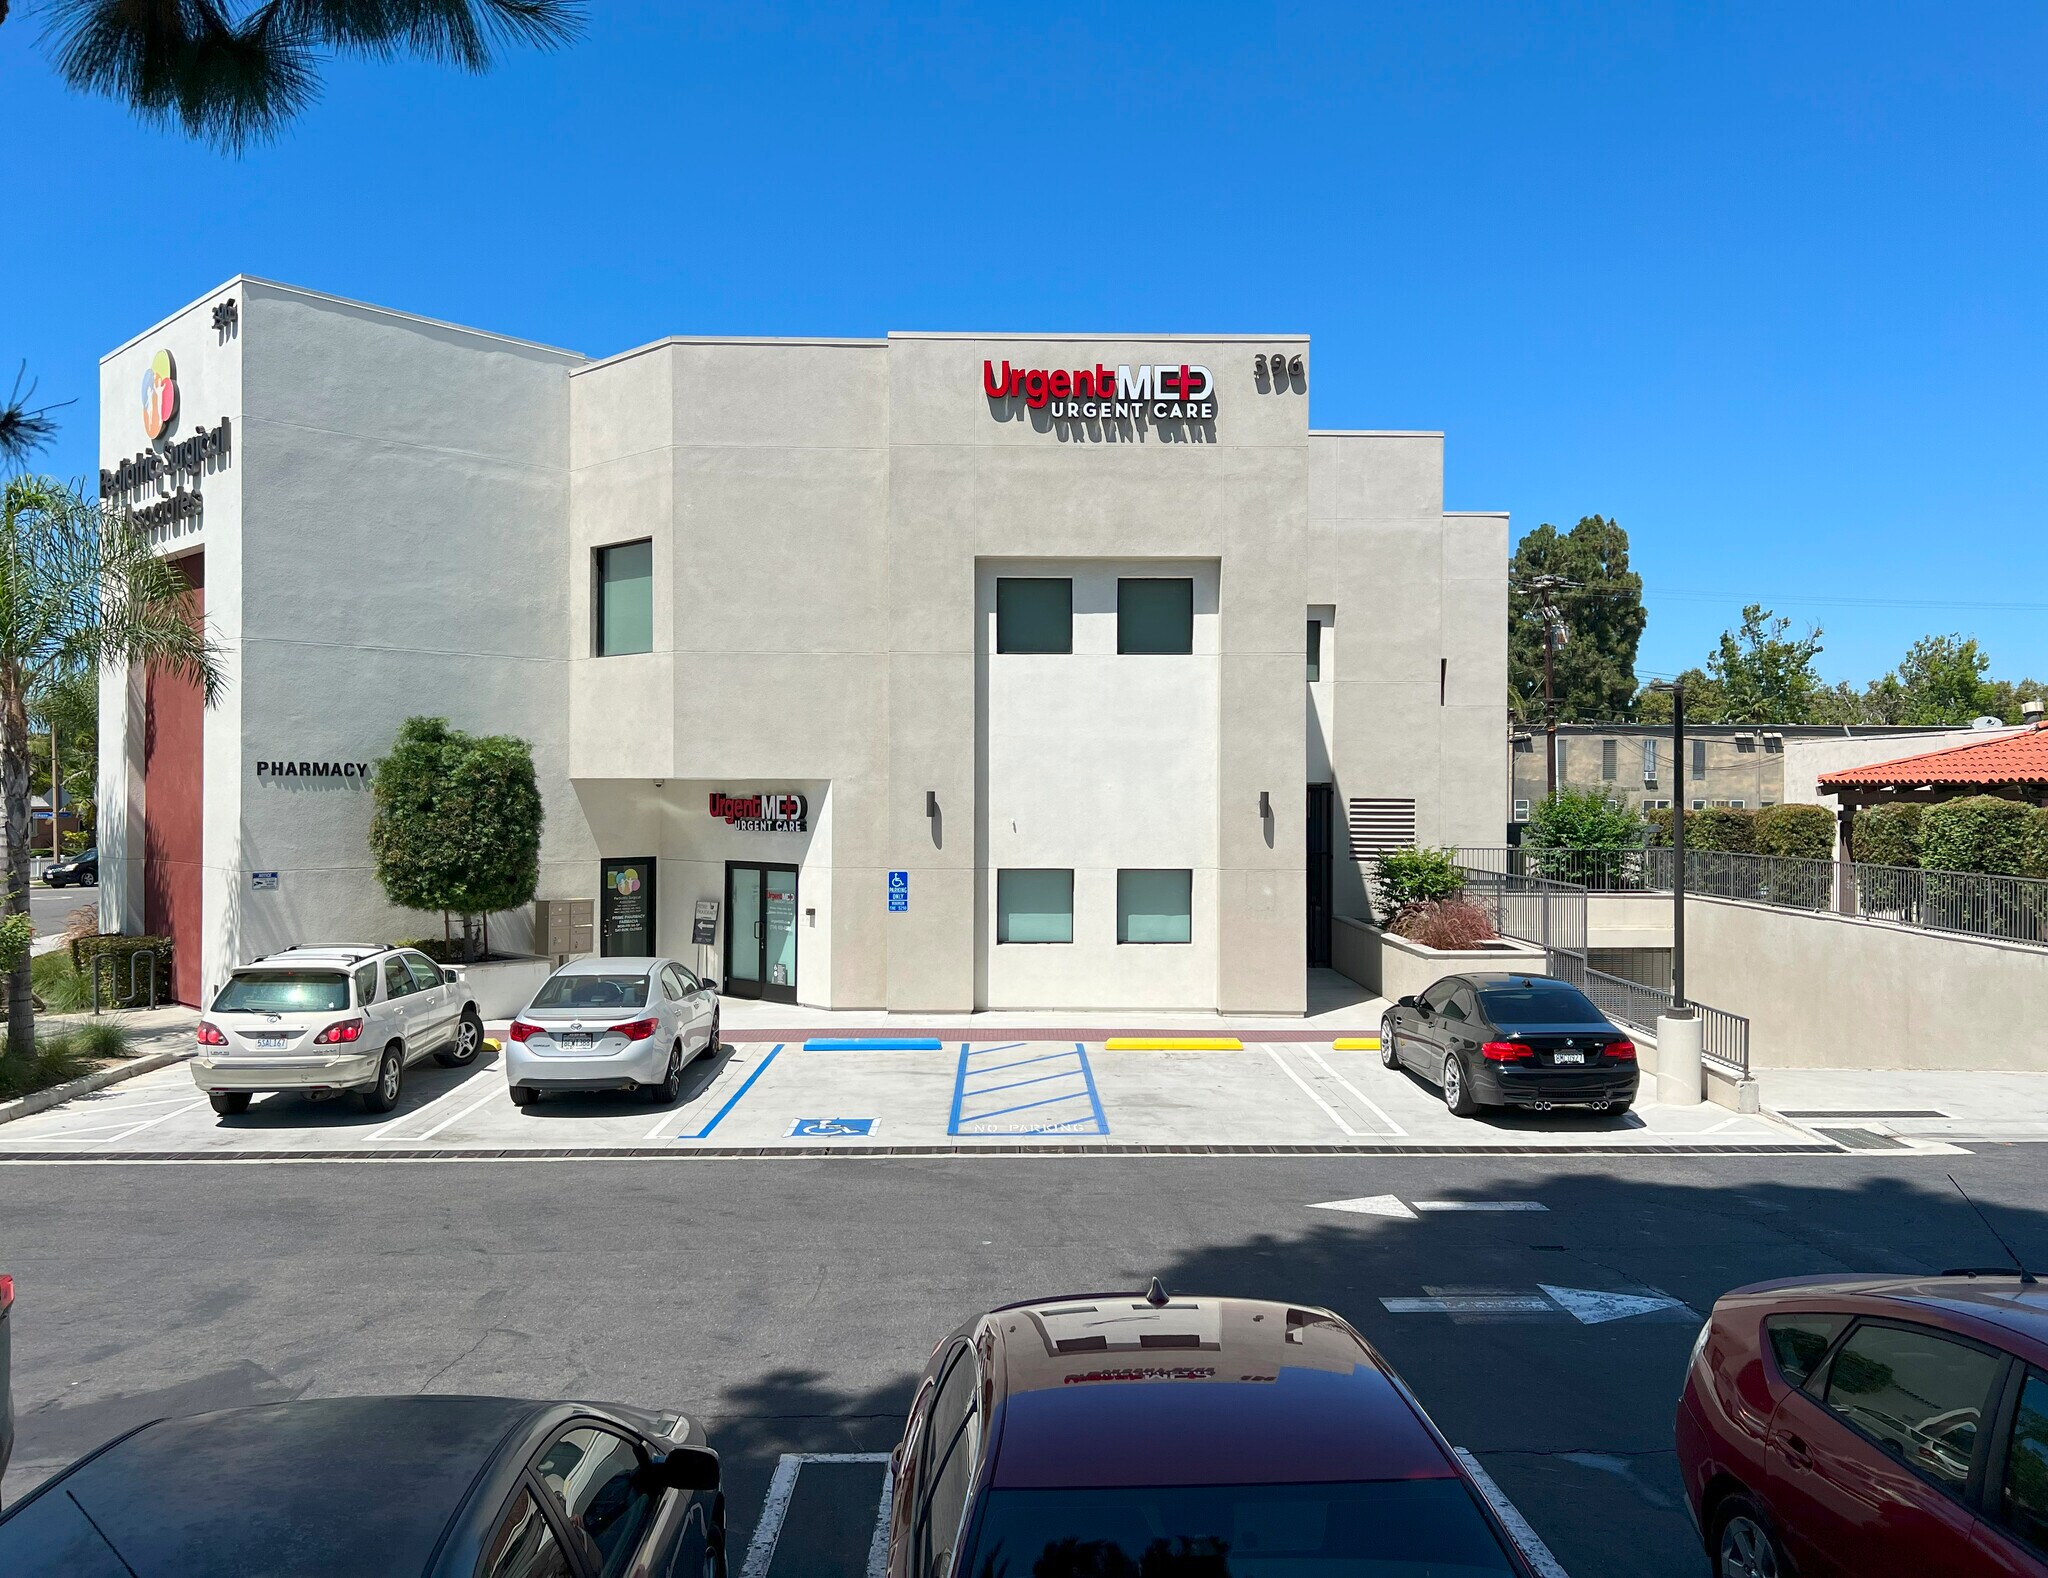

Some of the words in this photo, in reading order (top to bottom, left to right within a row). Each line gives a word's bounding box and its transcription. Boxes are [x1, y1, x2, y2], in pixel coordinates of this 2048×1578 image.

[1253, 353, 1303, 376] 396
[1051, 402, 1143, 418] URGENT
[1153, 402, 1213, 418] CARE
[99, 447, 164, 499] Pediatric
[163, 416, 229, 477] Surgical
[256, 761, 368, 777] PHARMACY
[734, 820, 773, 831] URGENT
[775, 821, 801, 832] CARE
[974, 1124, 998, 1132] NO
[1009, 1124, 1085, 1132] PARKING
